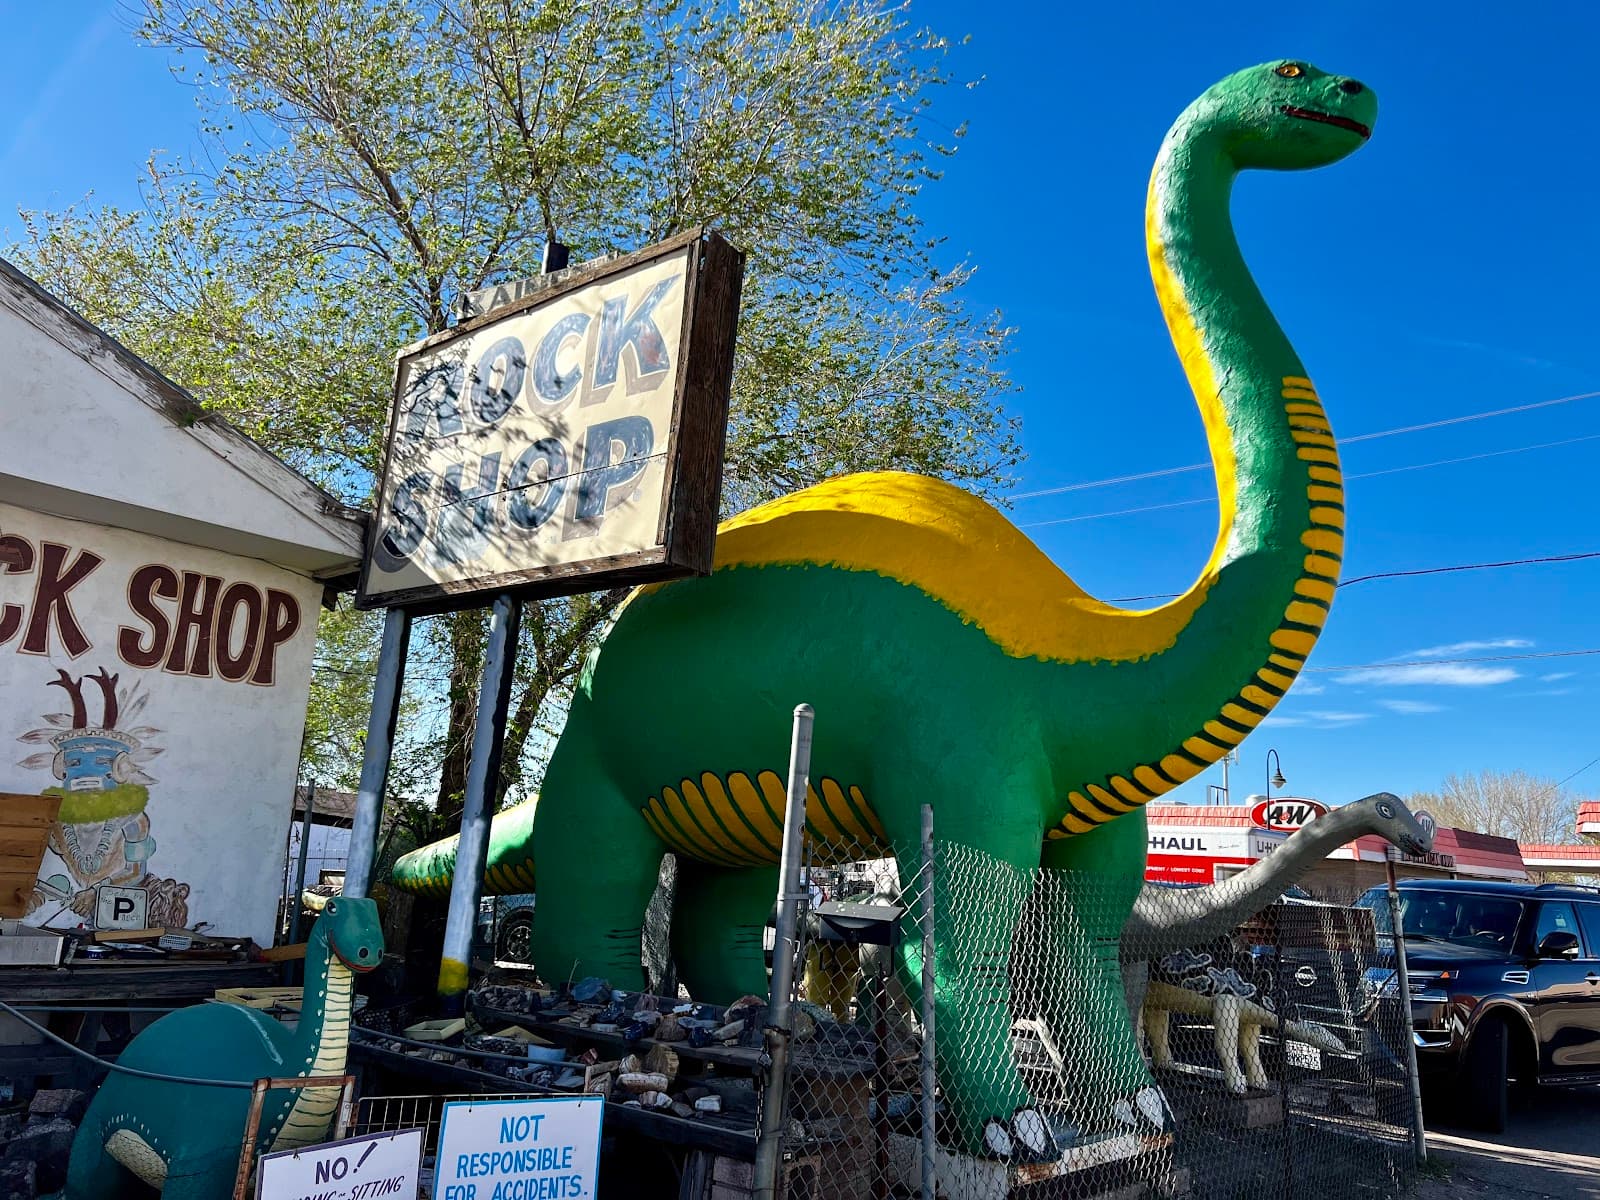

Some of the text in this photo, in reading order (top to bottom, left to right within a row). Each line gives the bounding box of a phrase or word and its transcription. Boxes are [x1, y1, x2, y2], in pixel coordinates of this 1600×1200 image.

[402, 273, 682, 442] ROCK
[378, 414, 656, 560] SHOP
[117, 563, 302, 688] SHOP
[1148, 836, 1208, 851] -HAUL
[499, 1114, 546, 1144] NOT
[315, 1141, 378, 1185] NO!
[456, 1146, 574, 1179] RESPONSIBLE
[350, 1175, 405, 1200] SITTING
[445, 1174, 589, 1200] FOR ACCIDENTS.
